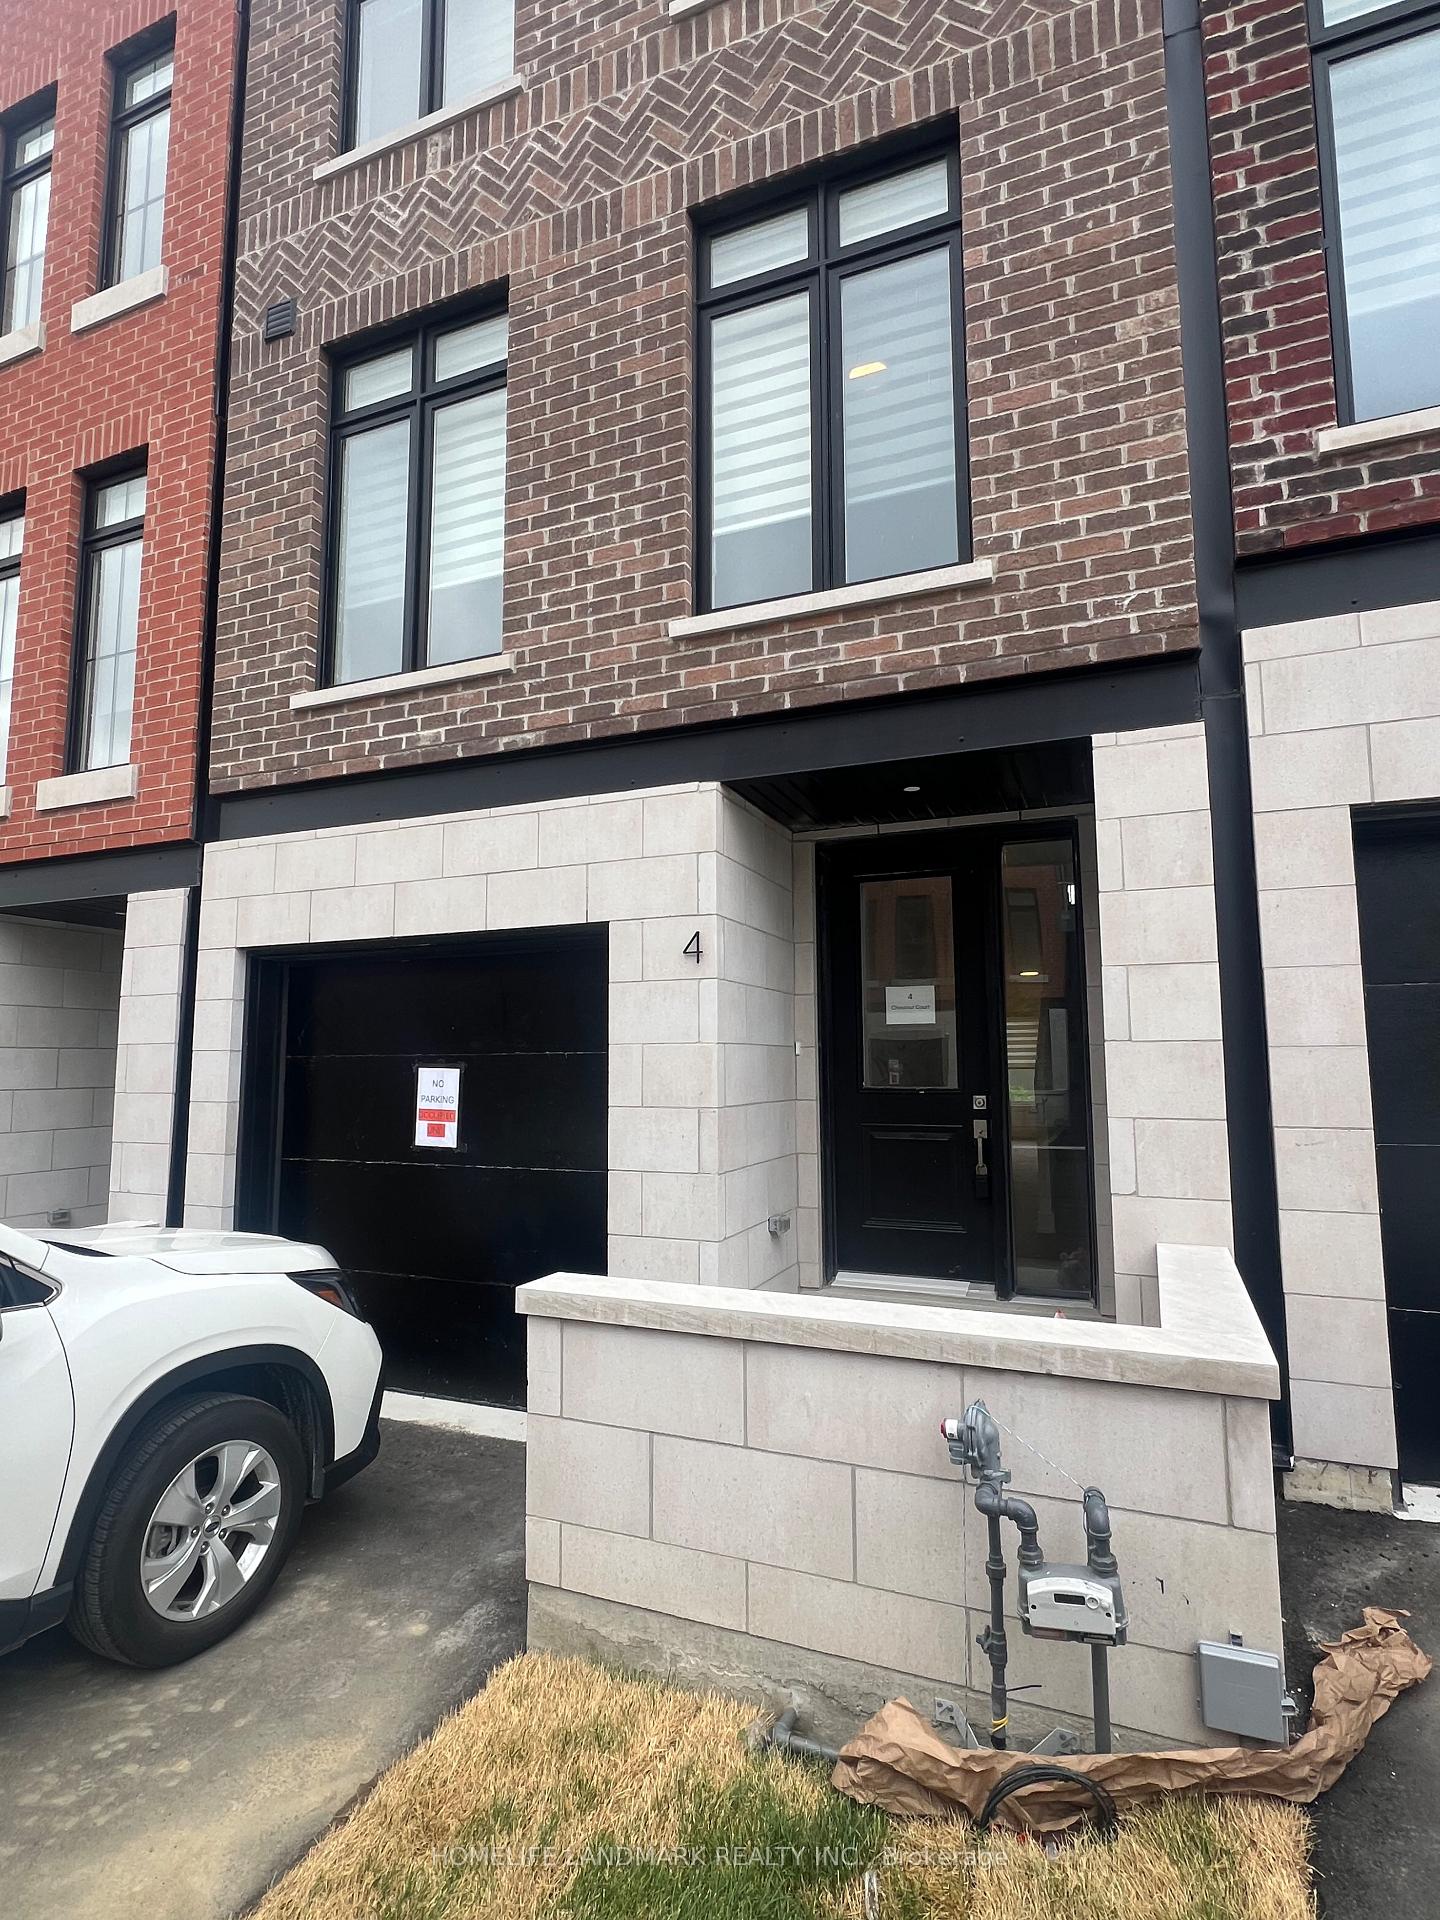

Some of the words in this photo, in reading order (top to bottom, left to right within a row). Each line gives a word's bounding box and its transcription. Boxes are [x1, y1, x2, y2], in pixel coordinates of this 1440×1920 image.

[682, 931, 704, 964] 4
[432, 1079, 445, 1088] NO
[420, 1094, 455, 1105] PARKING
